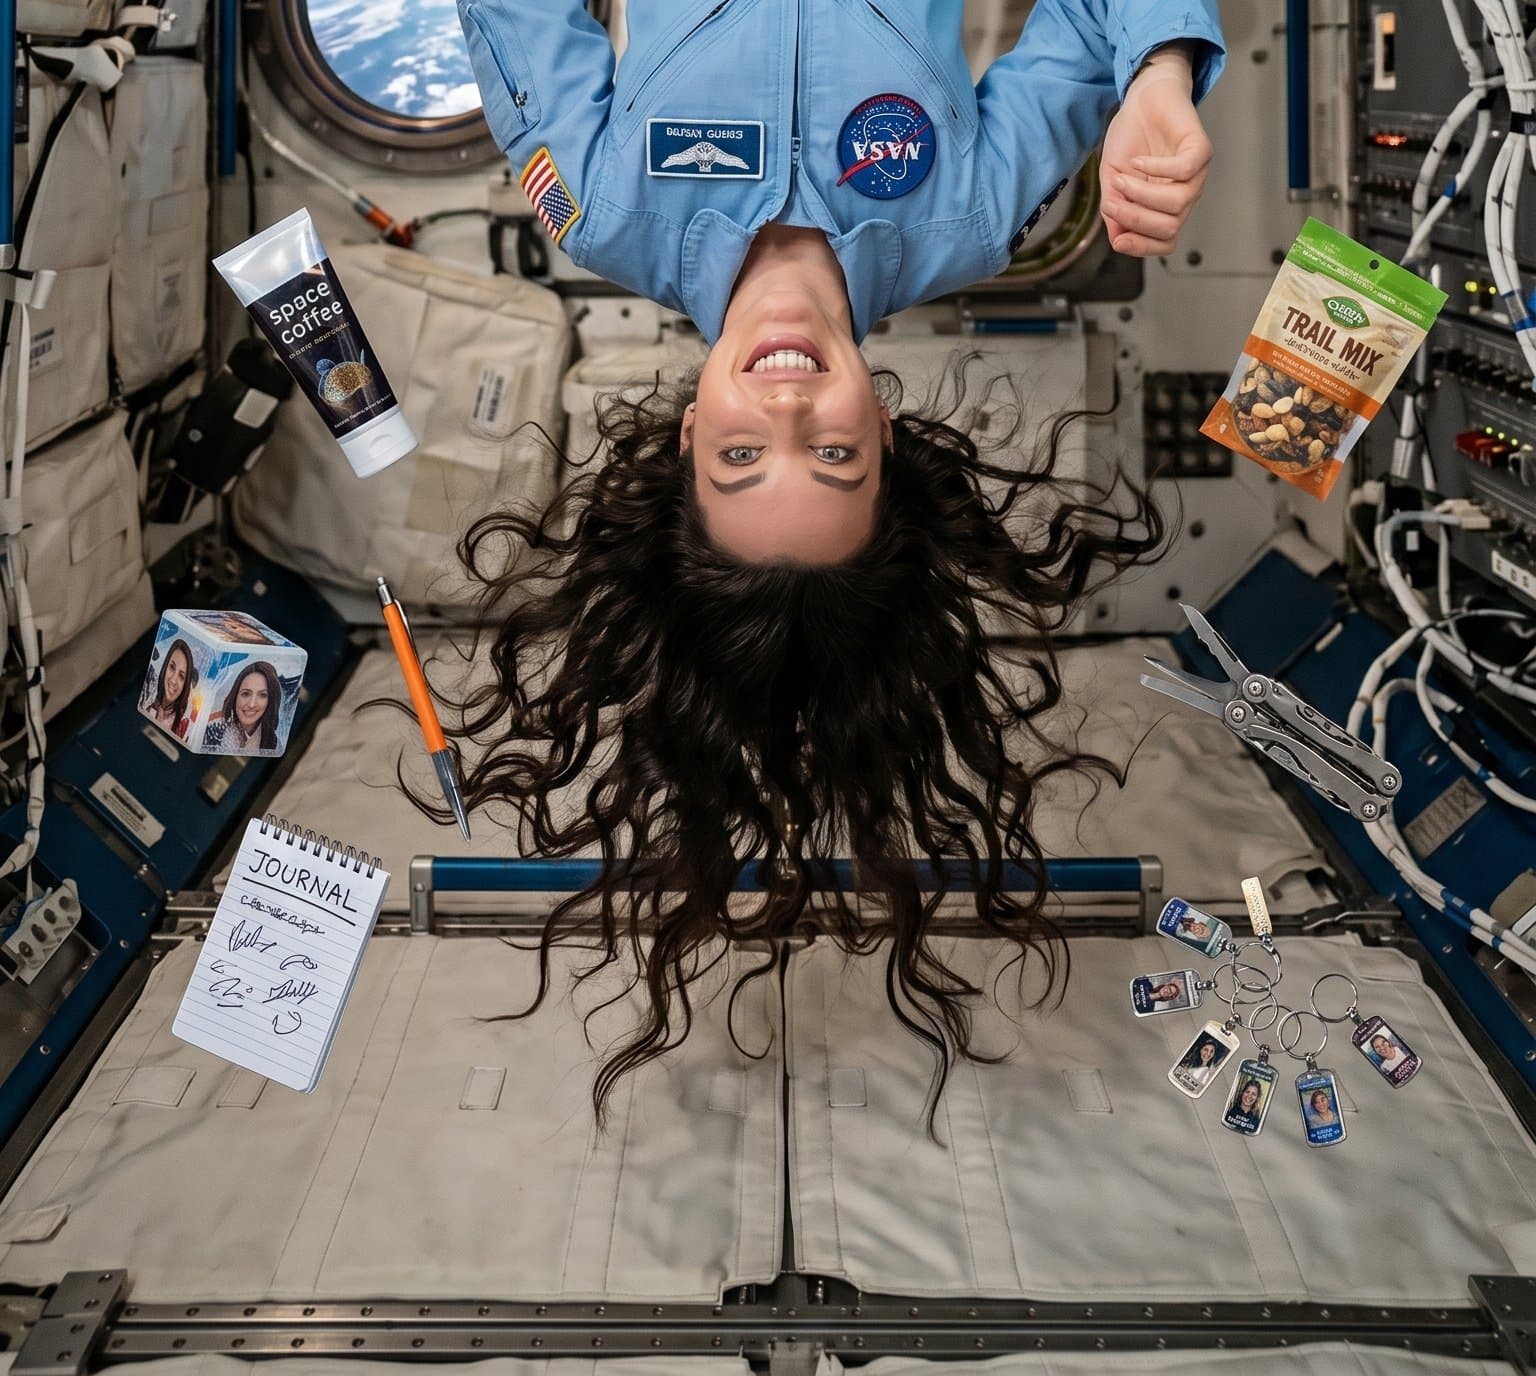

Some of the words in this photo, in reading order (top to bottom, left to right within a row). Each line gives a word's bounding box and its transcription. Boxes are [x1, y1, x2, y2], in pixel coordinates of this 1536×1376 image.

[852, 141, 921, 161] NASA
[269, 281, 331, 325] space
[280, 300, 344, 345] coffee
[1281, 306, 1340, 354] TRAIL
[1340, 337, 1385, 376] MIX
[248, 848, 357, 913] JOURNAL
